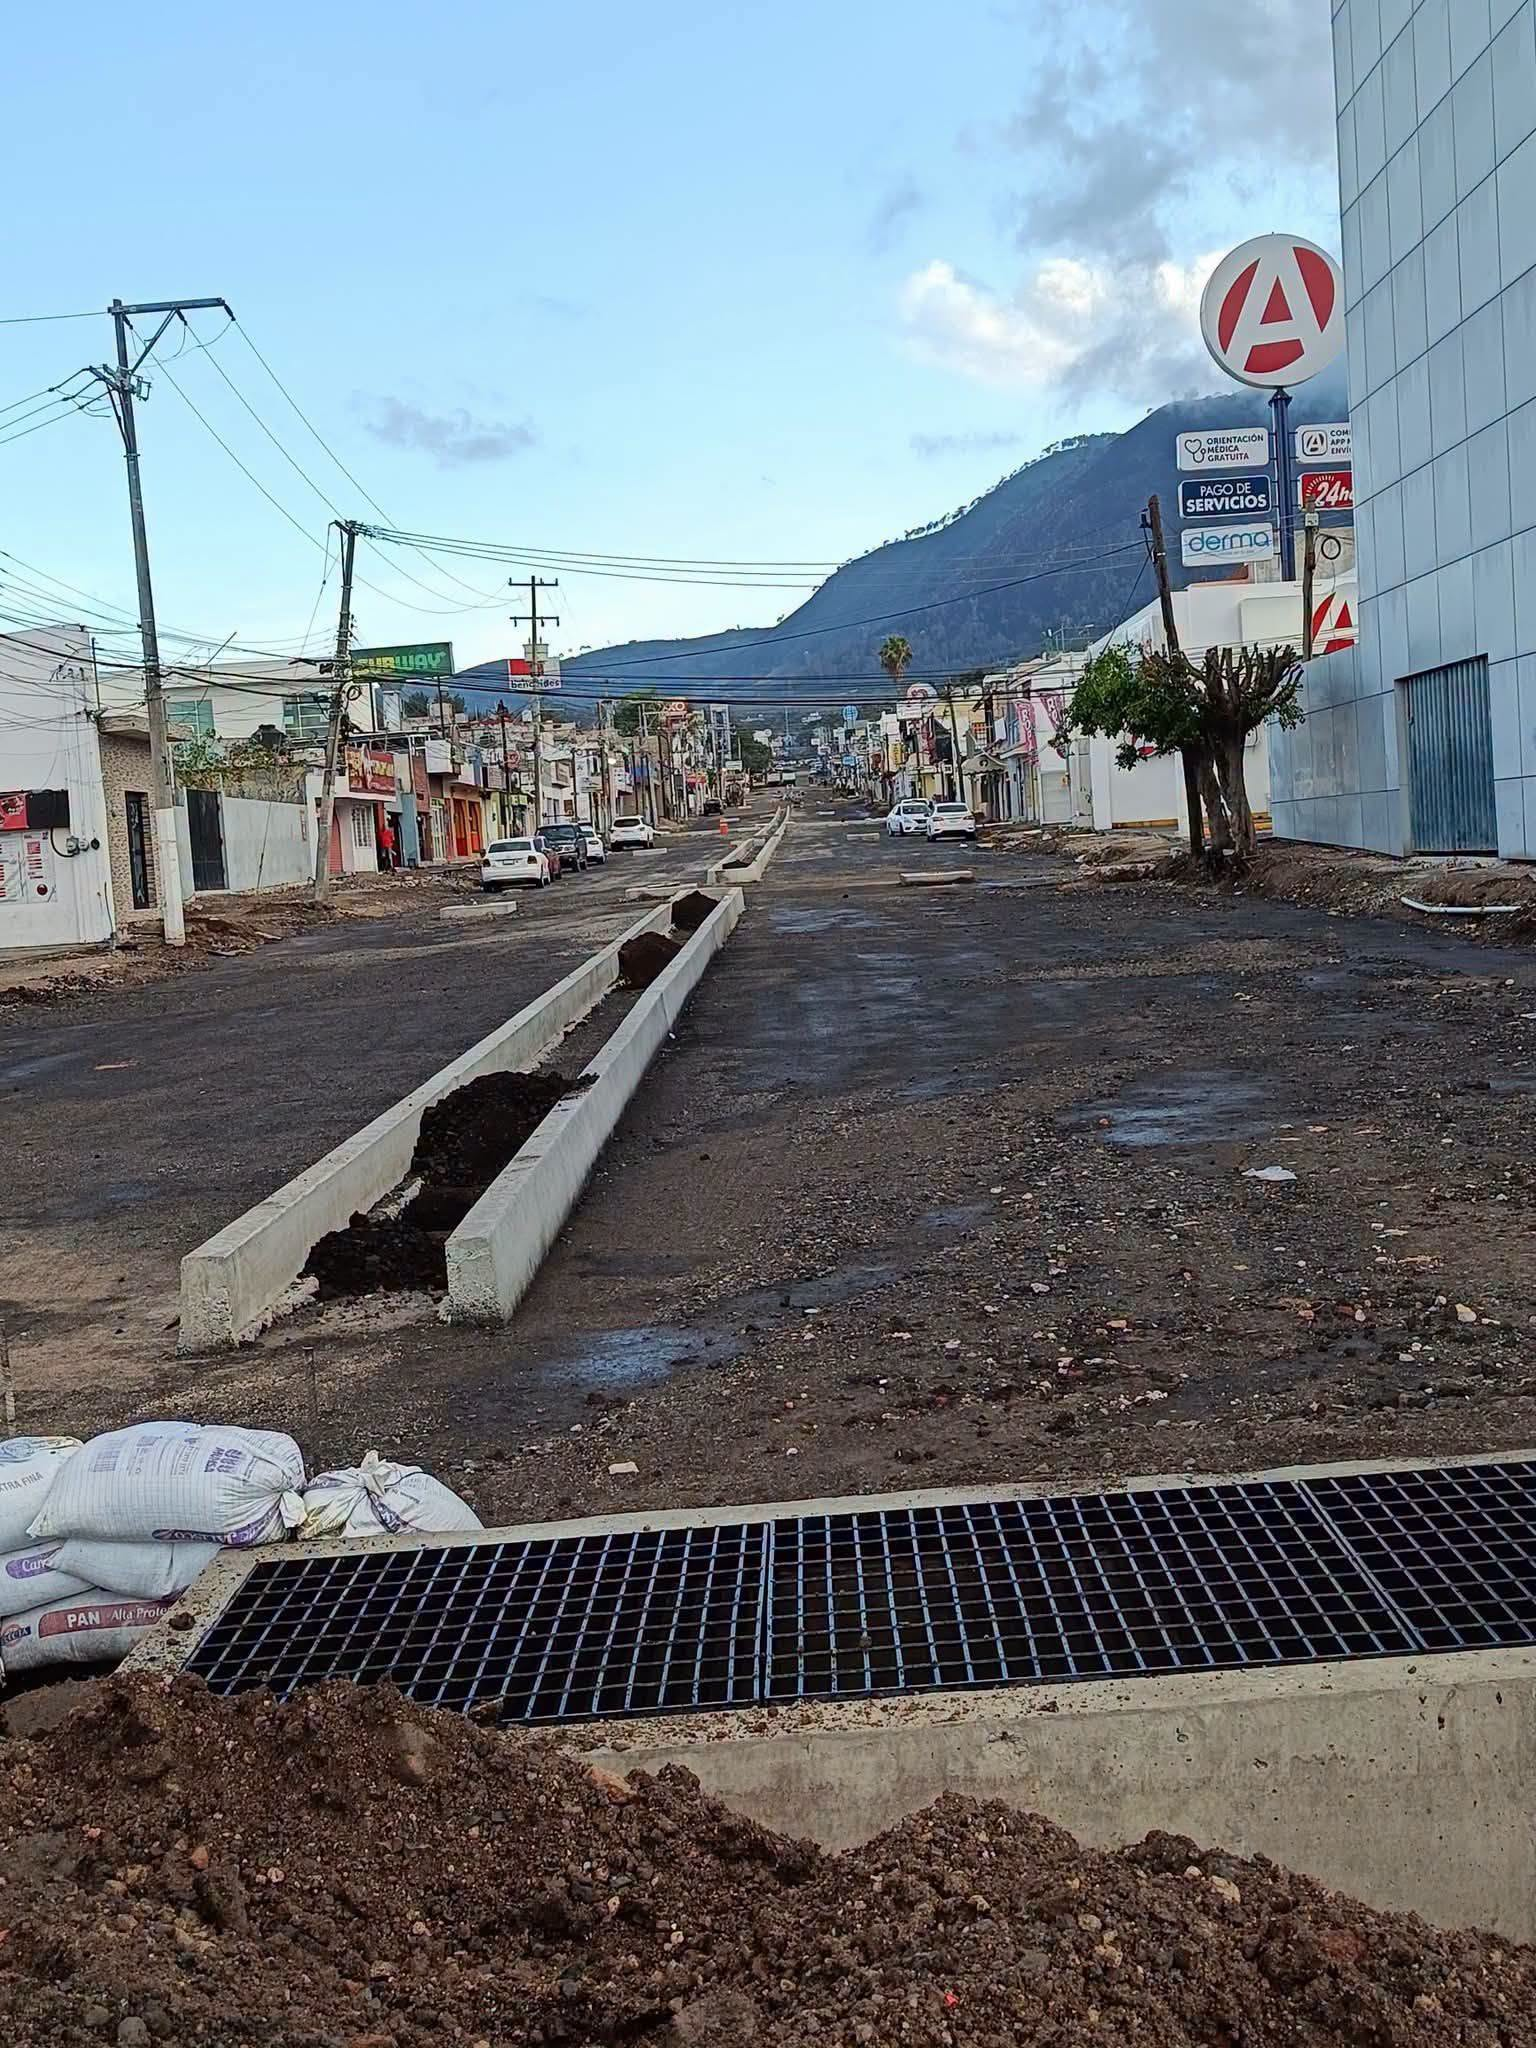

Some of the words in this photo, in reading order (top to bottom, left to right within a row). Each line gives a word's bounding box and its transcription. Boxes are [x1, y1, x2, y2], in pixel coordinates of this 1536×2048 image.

[1206, 434, 1264, 445] ORIENTACIÓN
[1330, 429, 1352, 437] COM
[1207, 444, 1240, 454] MÉDICA
[1331, 446, 1352, 454] ENVÍ
[1207, 453, 1249, 462] GRATUITA
[1200, 483, 1234, 497] PAGO
[1236, 482, 1252, 494] DE
[1186, 494, 1267, 513] SERVICIOS
[1189, 531, 1271, 552] derma
[21, 1471, 44, 1486] FINA
[66, 1610, 100, 1629] PAN
[110, 1607, 133, 1621] Alta
[136, 1606, 167, 1619] Prote
